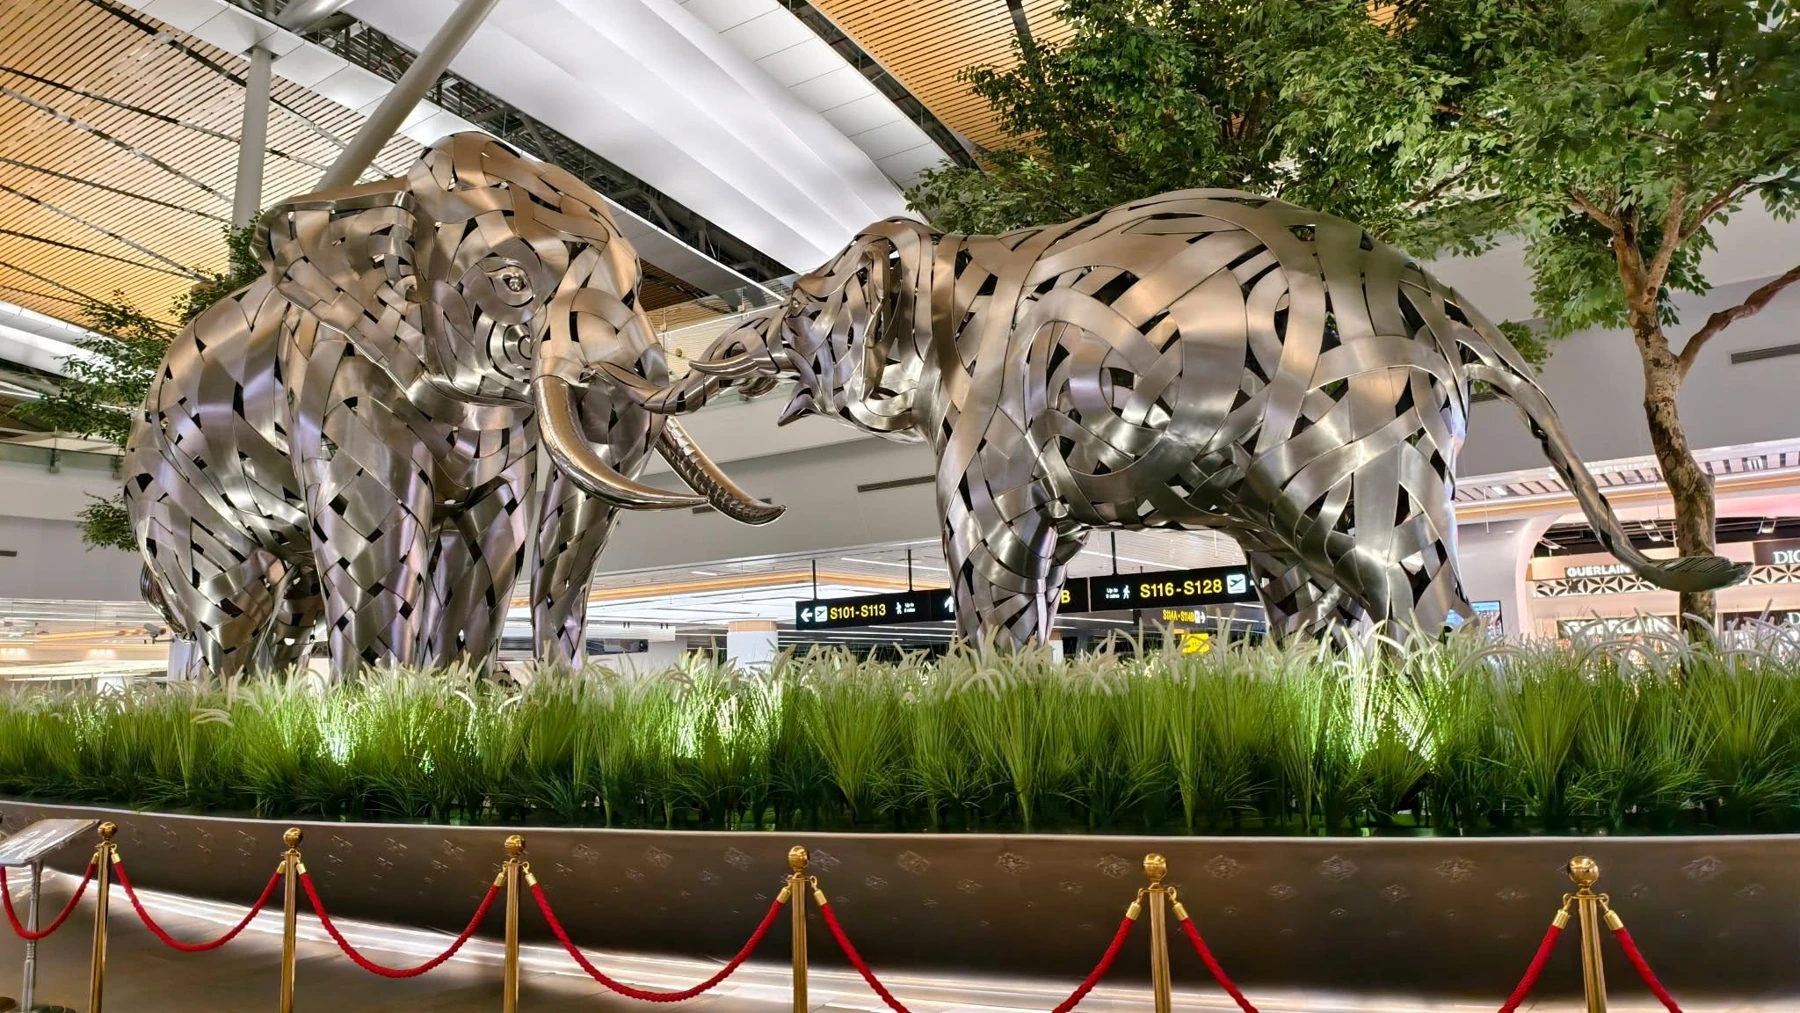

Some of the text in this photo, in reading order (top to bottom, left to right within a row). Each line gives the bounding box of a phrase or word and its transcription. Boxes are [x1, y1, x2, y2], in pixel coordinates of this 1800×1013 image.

[1567, 564, 1632, 577] GUERLAIN
[1140, 579, 1222, 598] S116-S128
[830, 603, 886, 620] S101-S113
